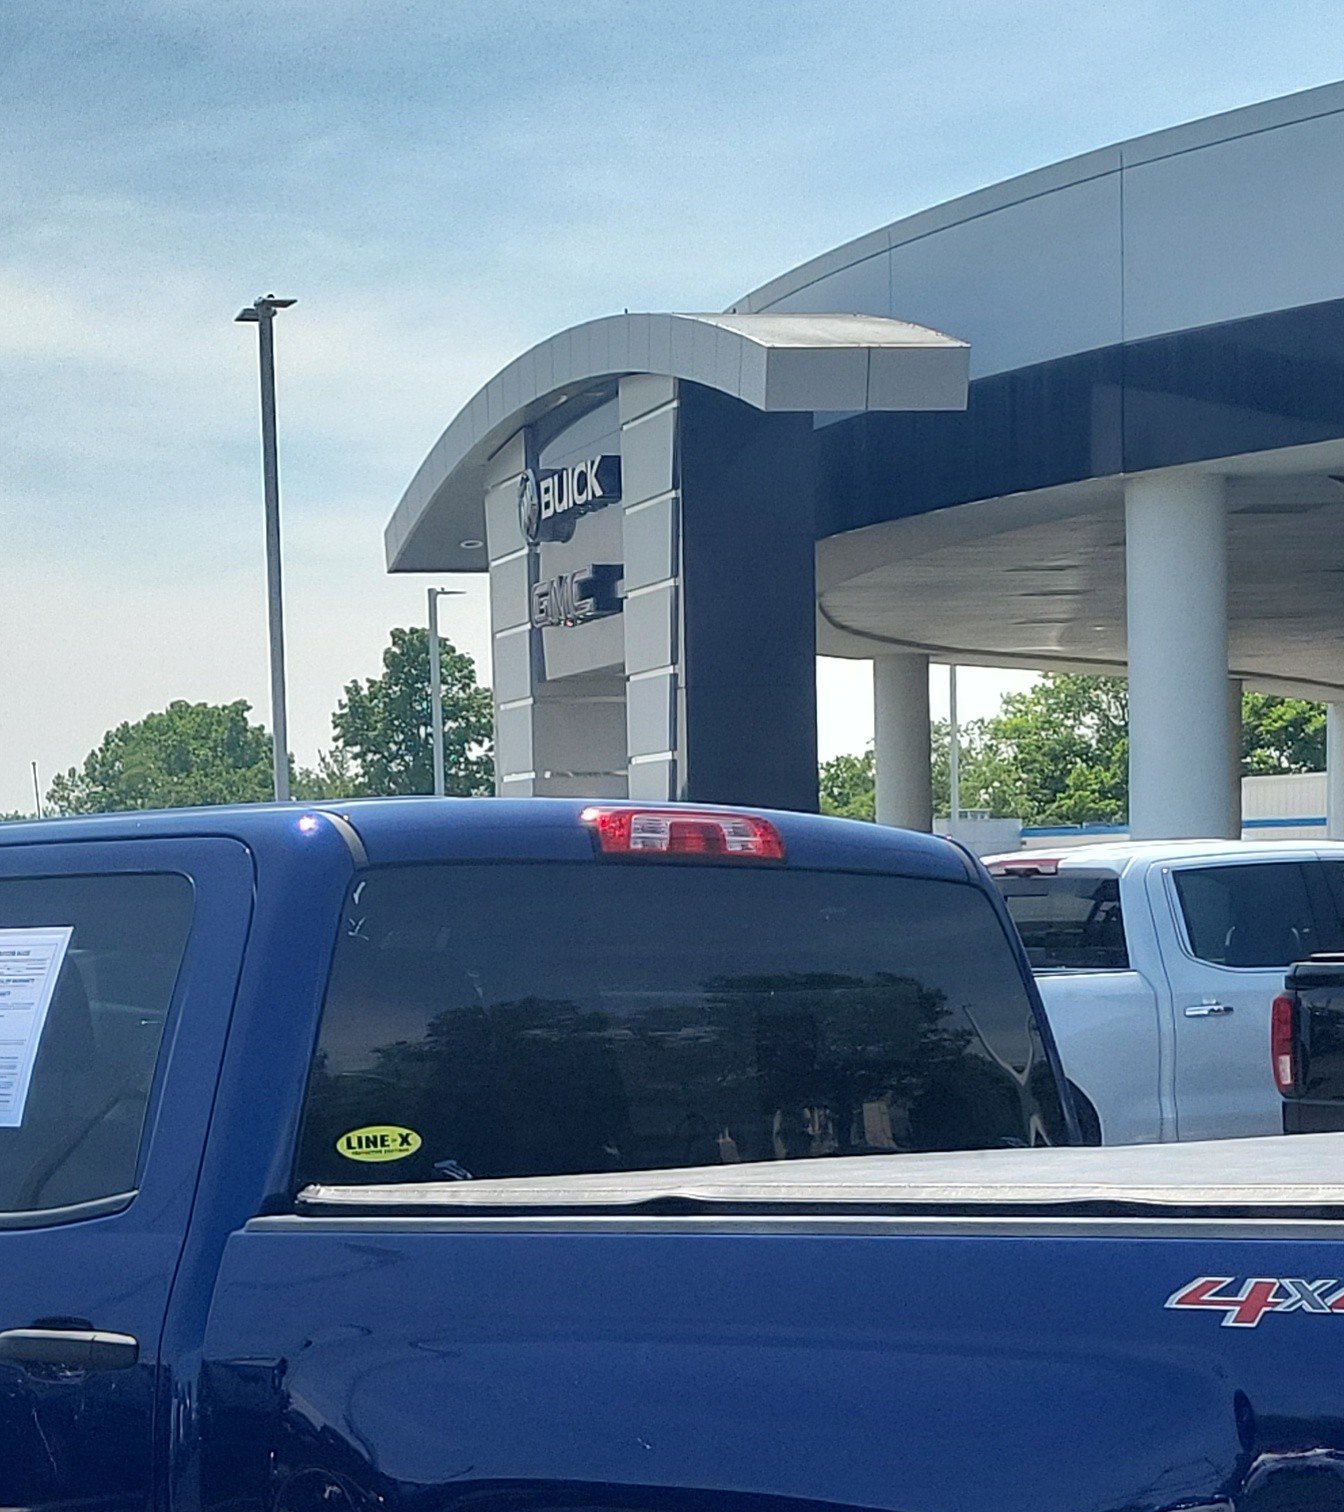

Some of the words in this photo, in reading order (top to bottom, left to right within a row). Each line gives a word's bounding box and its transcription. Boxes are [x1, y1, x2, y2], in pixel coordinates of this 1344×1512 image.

[540, 454, 604, 520] BUICK
[531, 565, 594, 628] GMC
[345, 1132, 413, 1150] LINE-X
